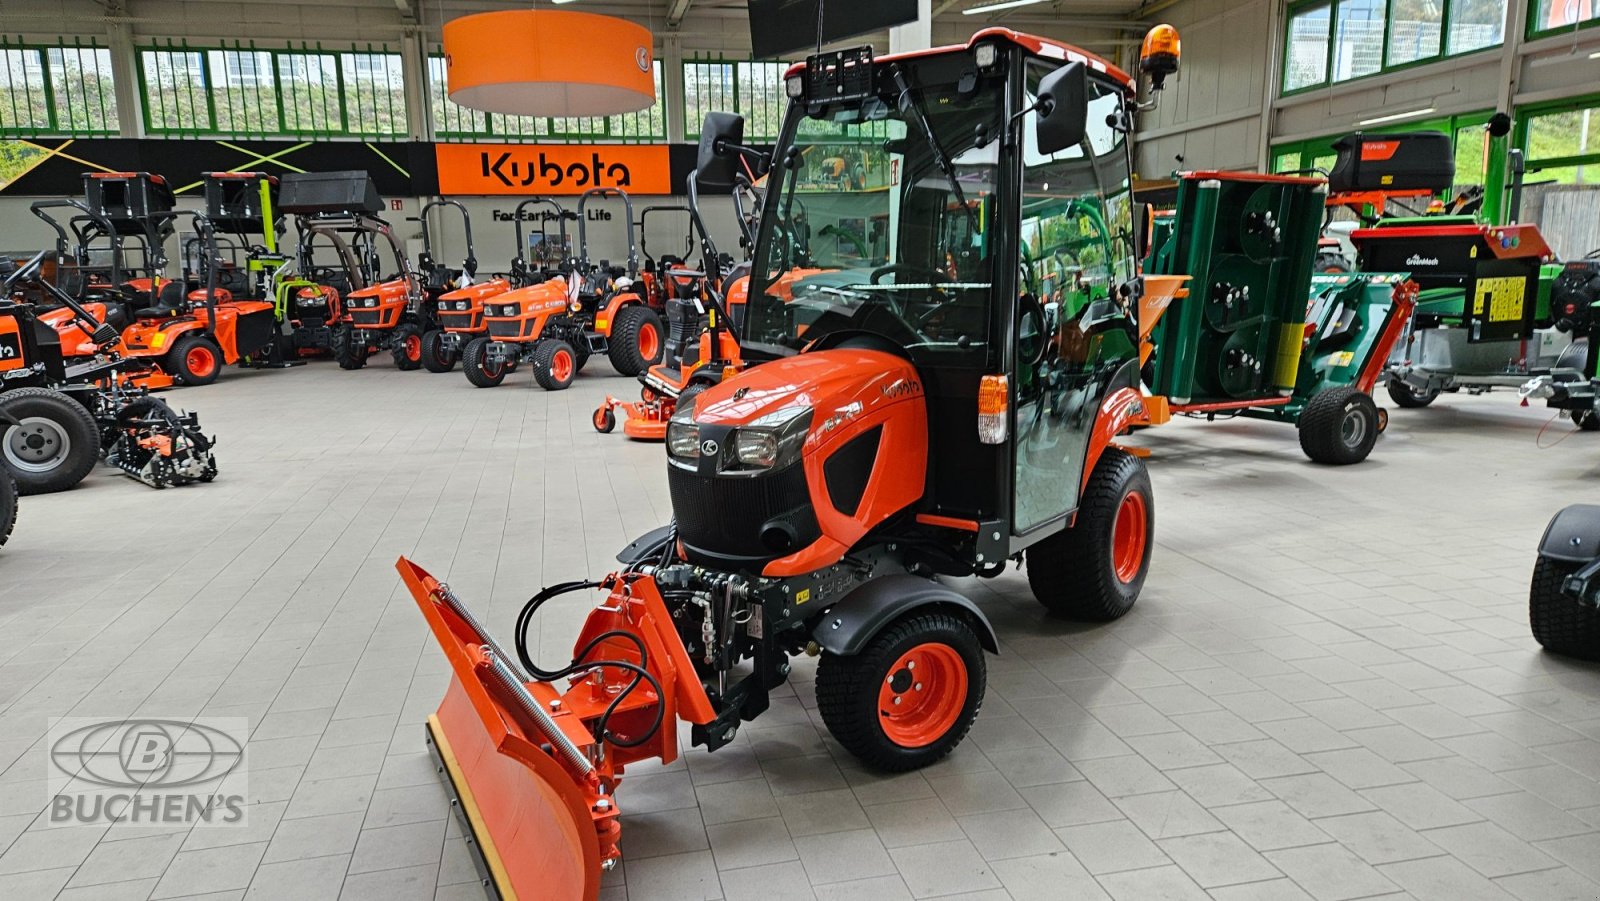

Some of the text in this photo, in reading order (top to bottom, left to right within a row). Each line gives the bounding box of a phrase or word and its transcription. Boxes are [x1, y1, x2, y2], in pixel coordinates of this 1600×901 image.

[480, 151, 631, 187] Kubota
[493, 209, 515, 222] For
[588, 209, 612, 221] Life
